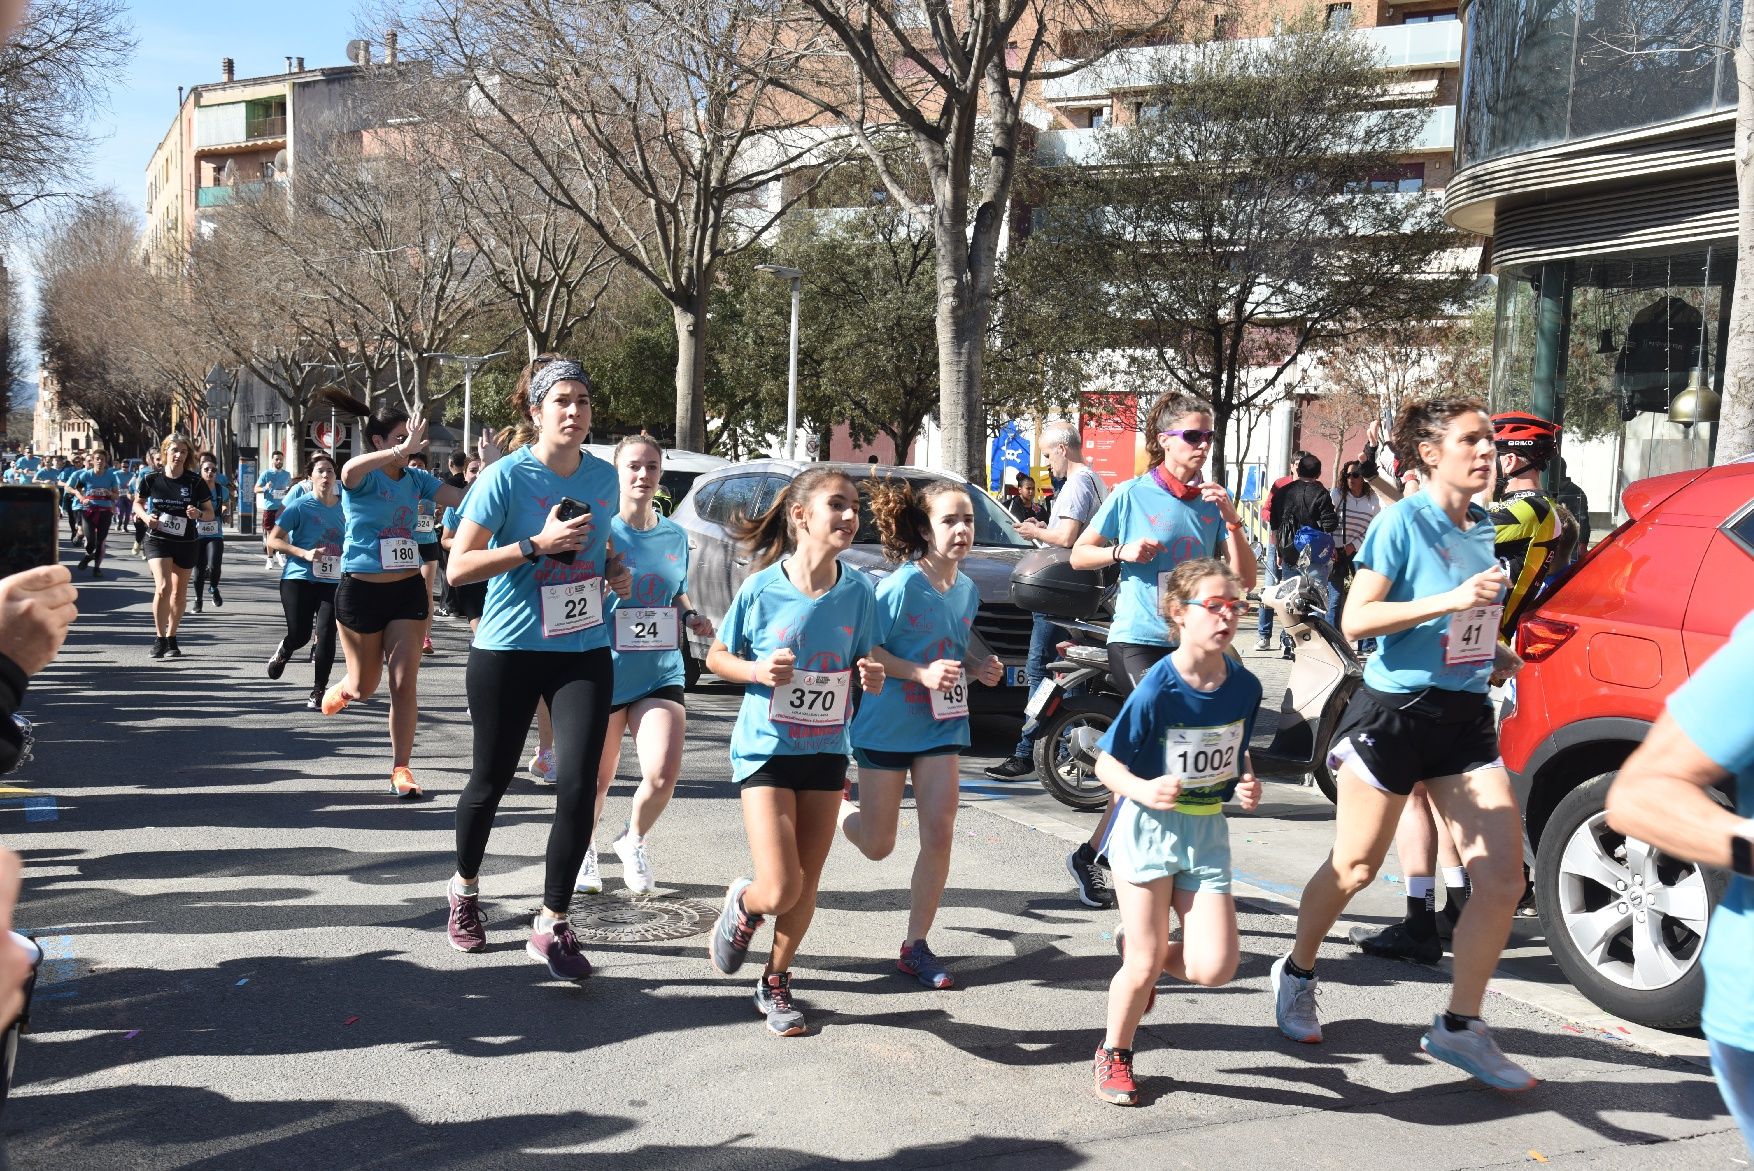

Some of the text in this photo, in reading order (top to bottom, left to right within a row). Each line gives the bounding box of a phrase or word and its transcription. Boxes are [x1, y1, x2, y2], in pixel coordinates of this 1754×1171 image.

[391, 547, 414, 561] 180
[321, 562, 333, 573] 51
[564, 597, 587, 620] 22
[634, 621, 658, 638] 24
[1462, 624, 1483, 645] 41
[789, 687, 835, 711] 370
[1177, 745, 1234, 773] 1002
